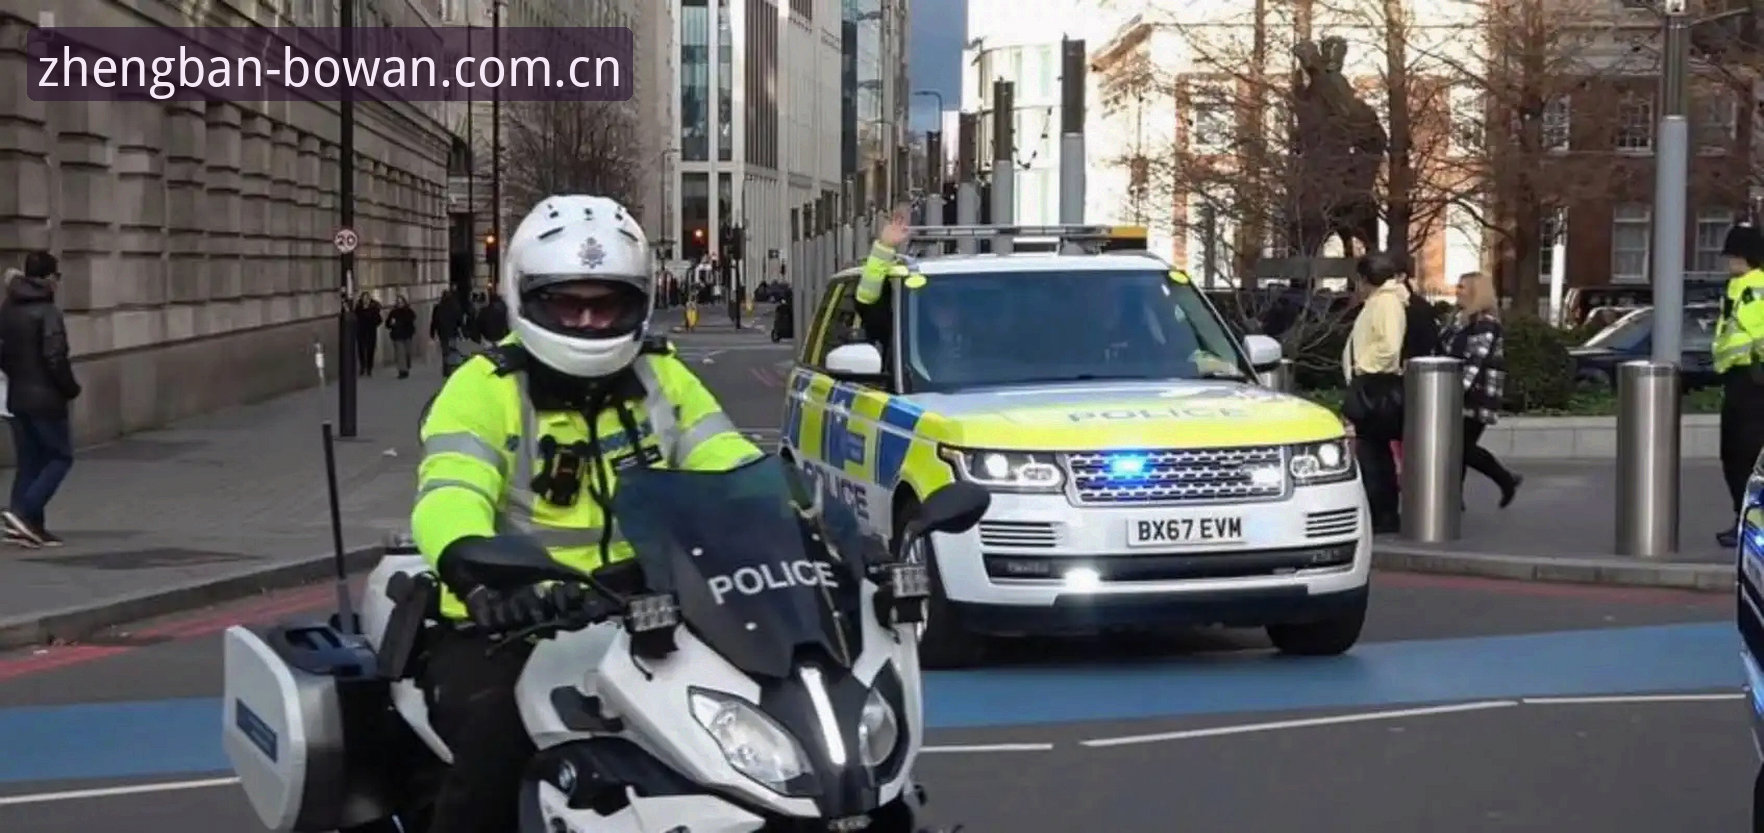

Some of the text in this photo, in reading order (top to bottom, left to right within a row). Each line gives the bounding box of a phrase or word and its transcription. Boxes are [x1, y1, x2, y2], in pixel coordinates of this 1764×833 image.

[337, 234, 357, 246] 20
[1068, 407, 1248, 422] POLICE
[1138, 517, 1242, 541] BX67 EVM
[708, 559, 839, 604] POLICE
